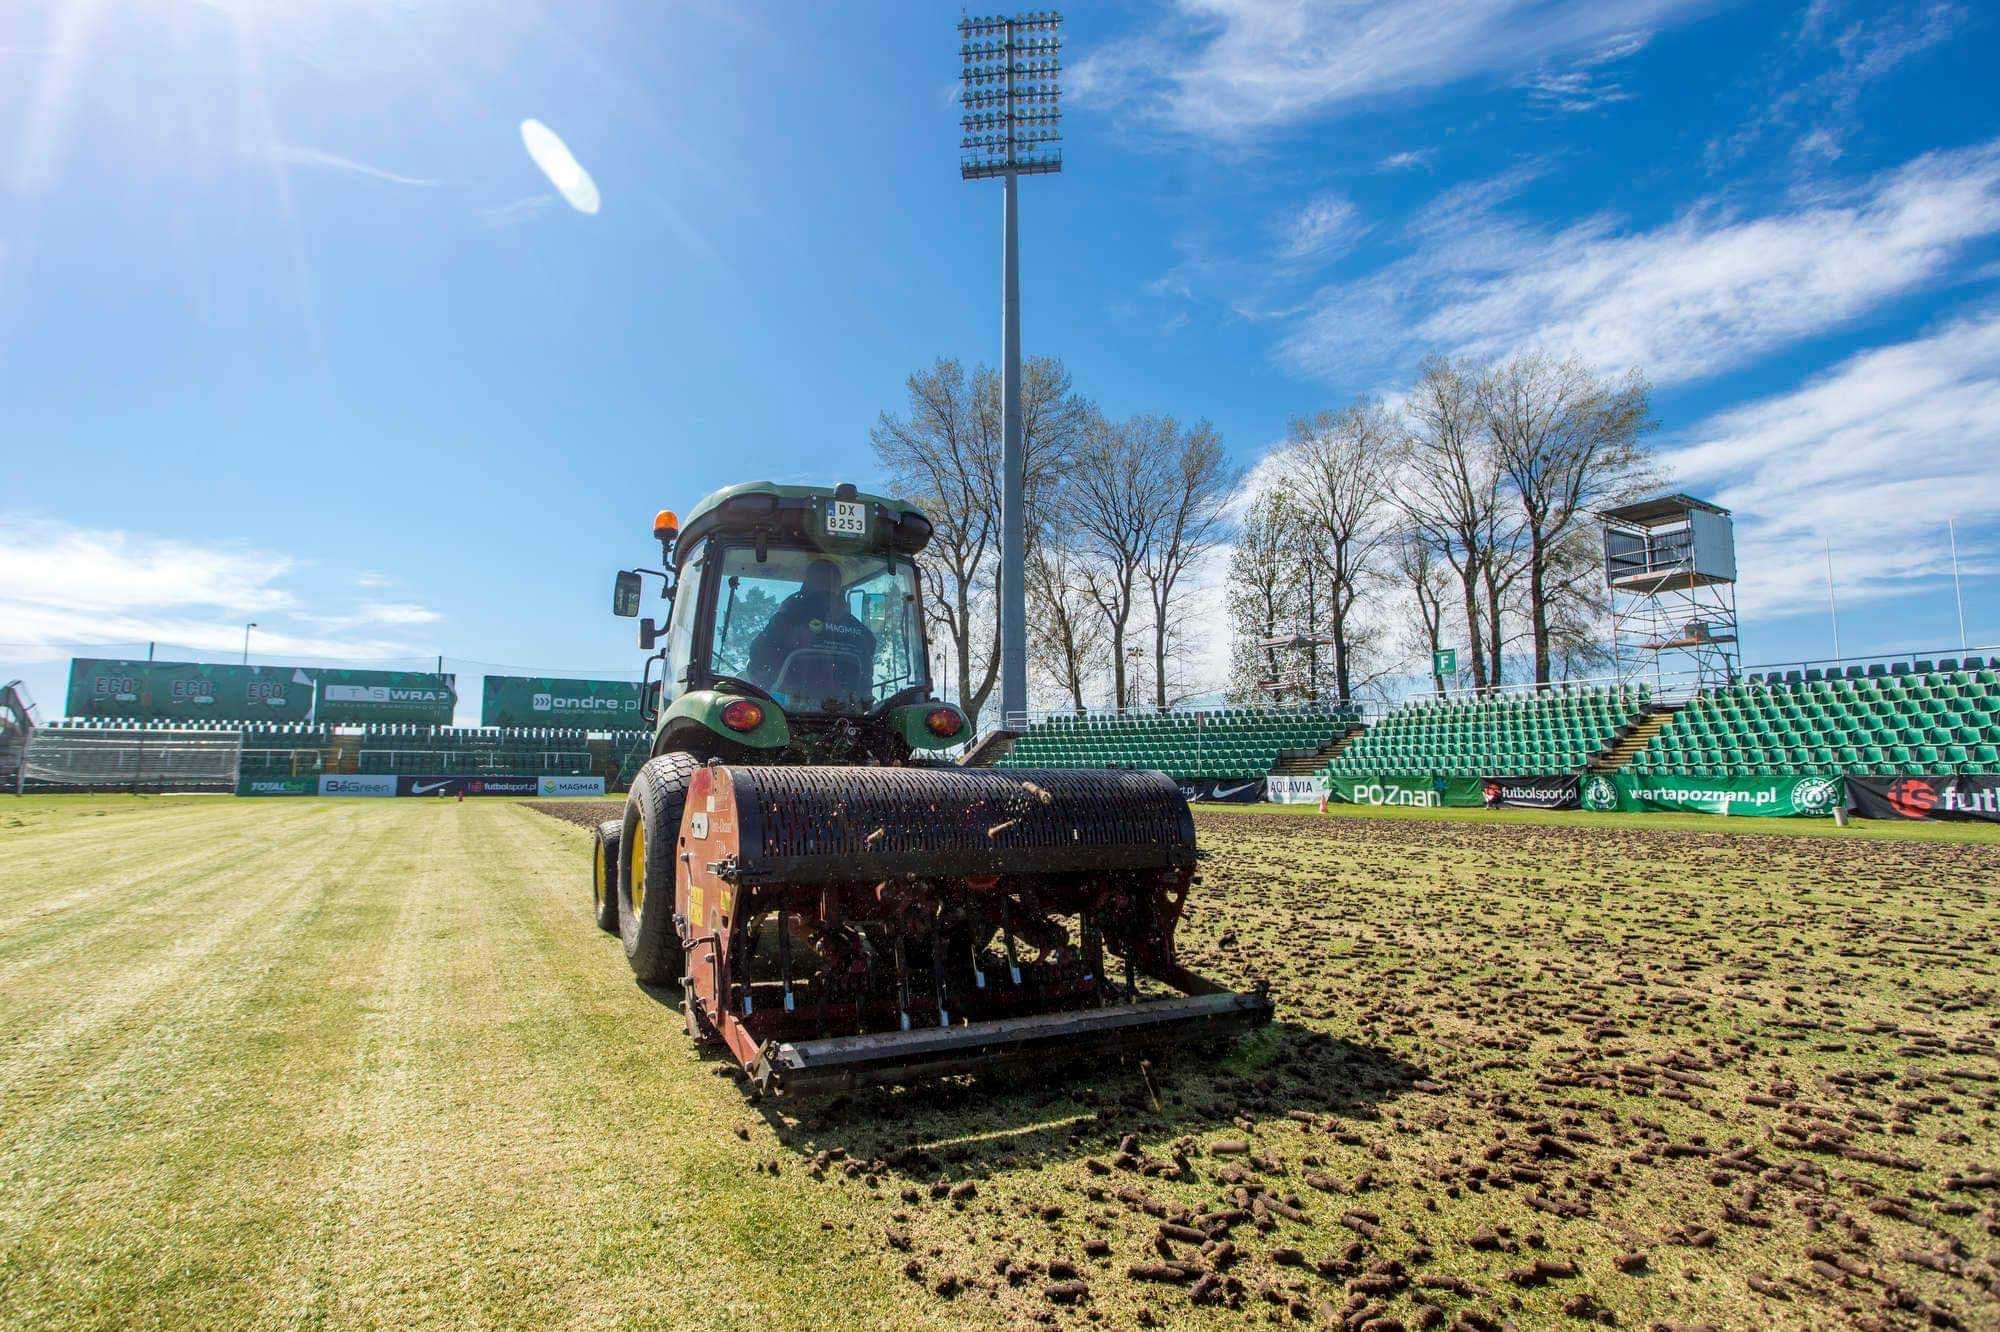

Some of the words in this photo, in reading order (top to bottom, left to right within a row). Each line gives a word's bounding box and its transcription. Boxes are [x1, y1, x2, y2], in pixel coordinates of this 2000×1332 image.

[839, 504, 855, 516] DX
[830, 518, 863, 531] 8253
[1440, 655, 1449, 669] F
[484, 782, 537, 792] futbolsport.pl
[559, 783, 599, 791] MAGMAR
[1270, 781, 1313, 793] AQUAVIA
[1502, 787, 1577, 801] futbolsport.pl
[1629, 787, 1777, 806] wartapoznan.pl
